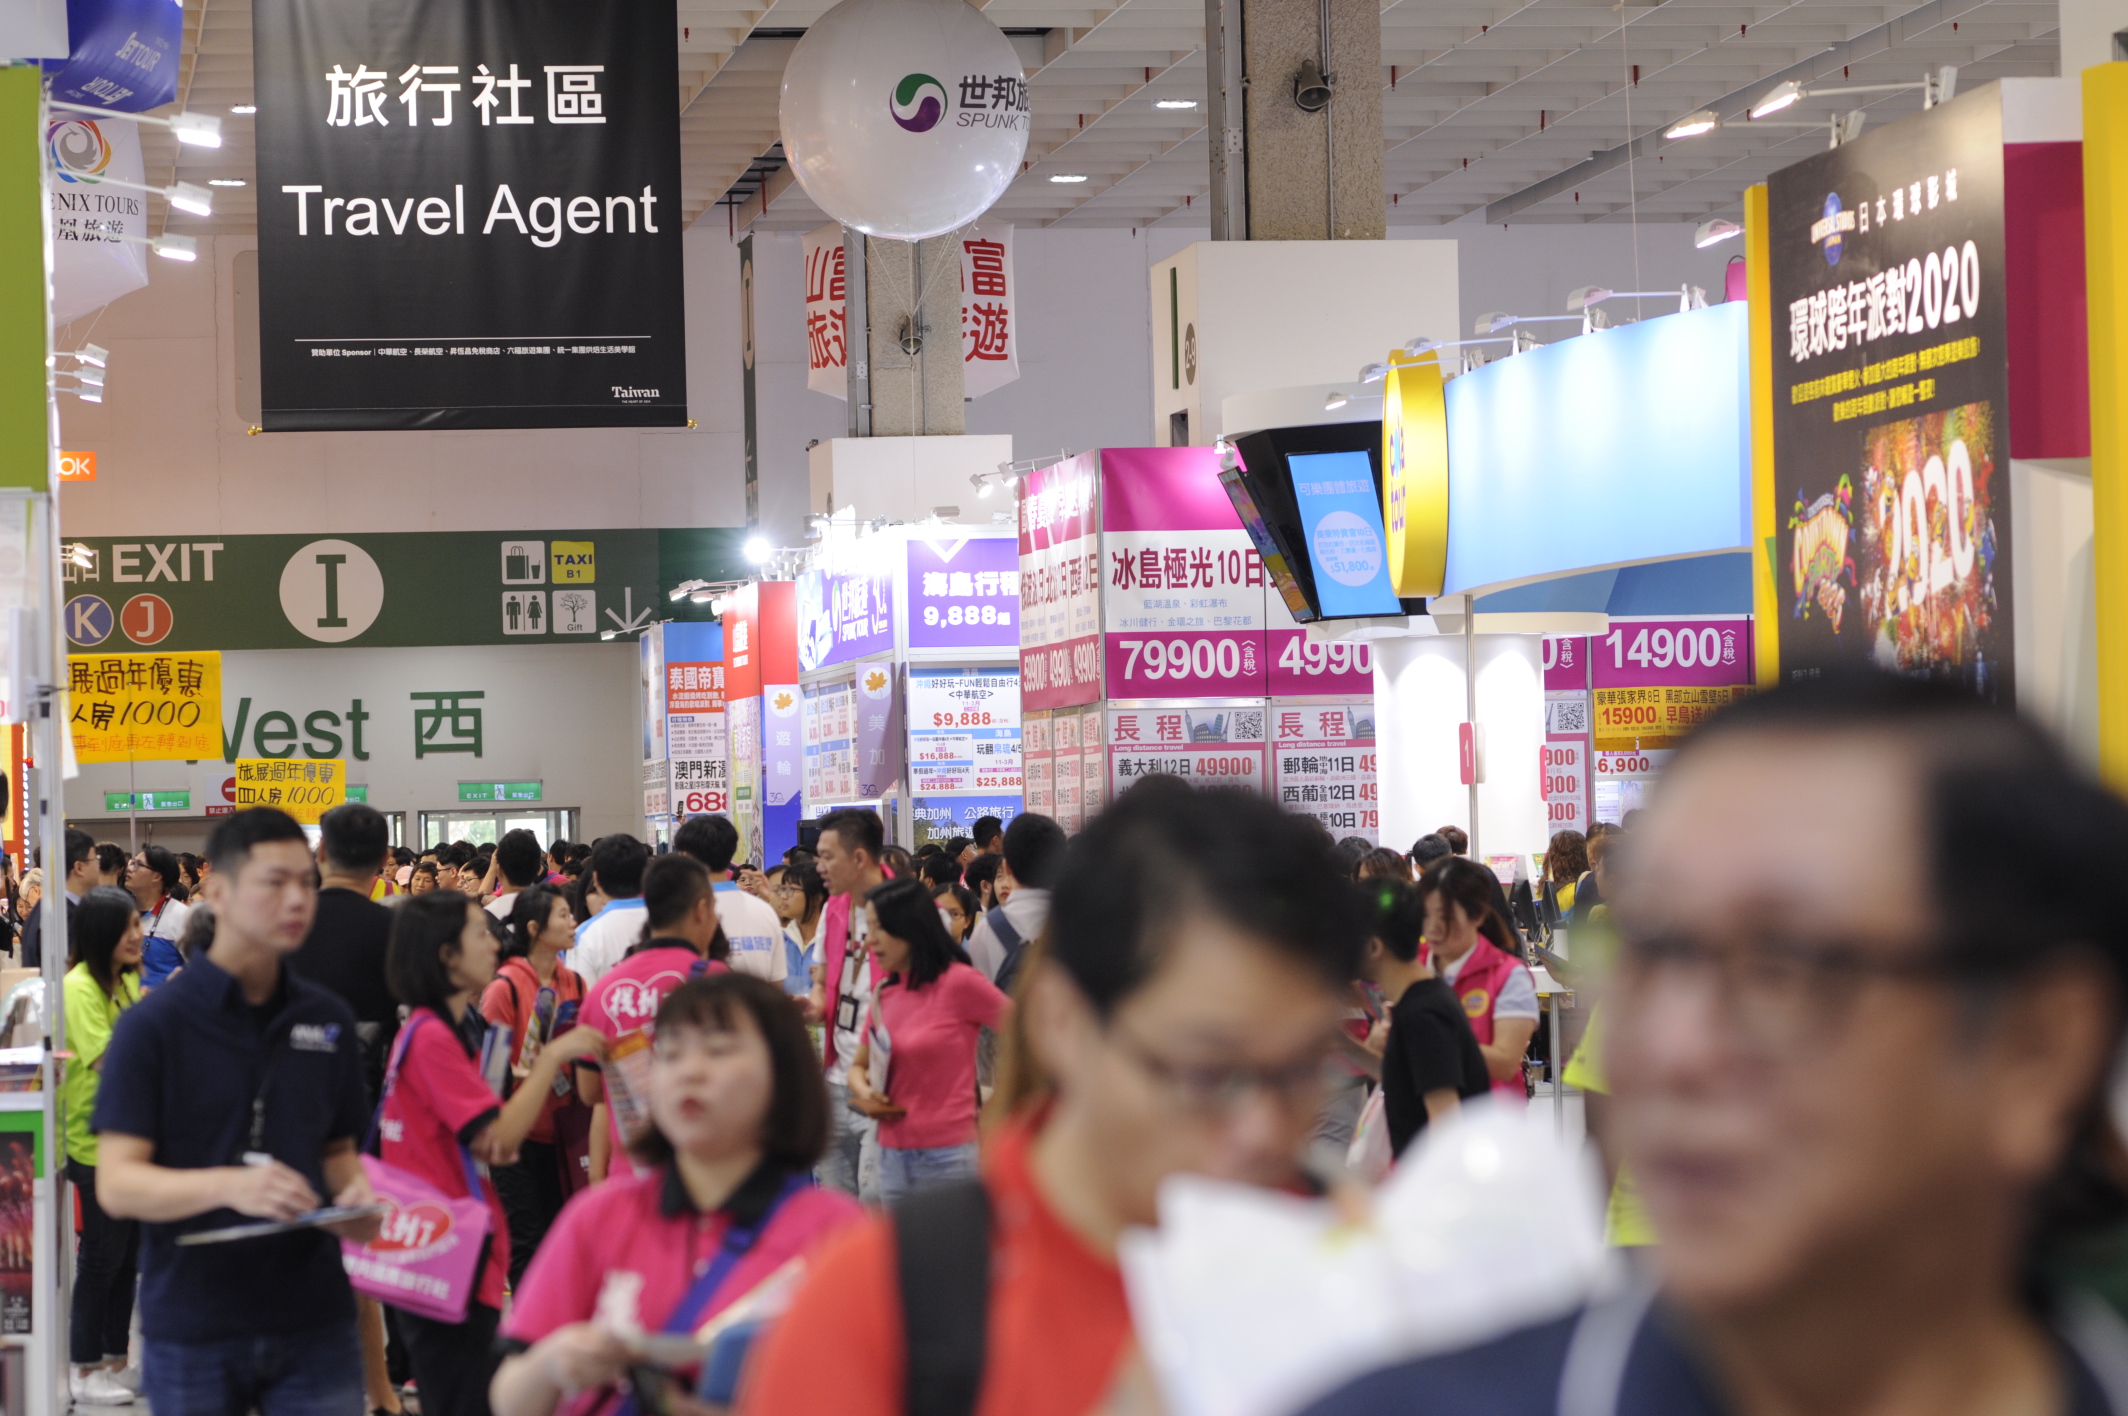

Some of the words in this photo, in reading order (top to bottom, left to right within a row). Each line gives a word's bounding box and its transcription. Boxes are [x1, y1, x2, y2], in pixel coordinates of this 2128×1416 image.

[130, 44, 161, 72] TOUR
[325, 63, 607, 127] 旅行社區
[956, 112, 1020, 131] SPUNK
[94, 194, 139, 216] TOURS
[281, 184, 465, 236] Travel
[483, 184, 659, 249] Agent
[960, 238, 1007, 296] 富
[1788, 239, 1981, 363] 環球跨年派對2020
[962, 302, 1009, 362] 遊
[341, 349, 372, 357] Sponsor
[611, 386, 661, 398] Taiwan
[1298, 479, 1370, 496] 可樂團體旅遊
[112, 543, 224, 582] EXIT
[554, 554, 593, 565] TAXI
[1111, 546, 1264, 591] 冰島極光10日
[566, 569, 581, 578] B1
[315, 554, 348, 628] I
[74, 602, 102, 639] K
[136, 601, 155, 638] J
[567, 623, 583, 632] Gift
[1606, 627, 1722, 668] 14900
[1119, 638, 1240, 680] 79900
[66, 657, 204, 697] 展過年優惠
[1596, 689, 1661, 706] 豪華張家界8日
[410, 690, 485, 759] 西
[933, 711, 991, 729] $9,888
[1602, 706, 1657, 725] 15900
[919, 752, 955, 761] $16,888
[1114, 745, 1132, 753] Long
[1195, 757, 1253, 776] 49900
[1594, 757, 1650, 775] 6,900
[976, 776, 1022, 787] $25,888
[1359, 810, 1379, 828] 79
